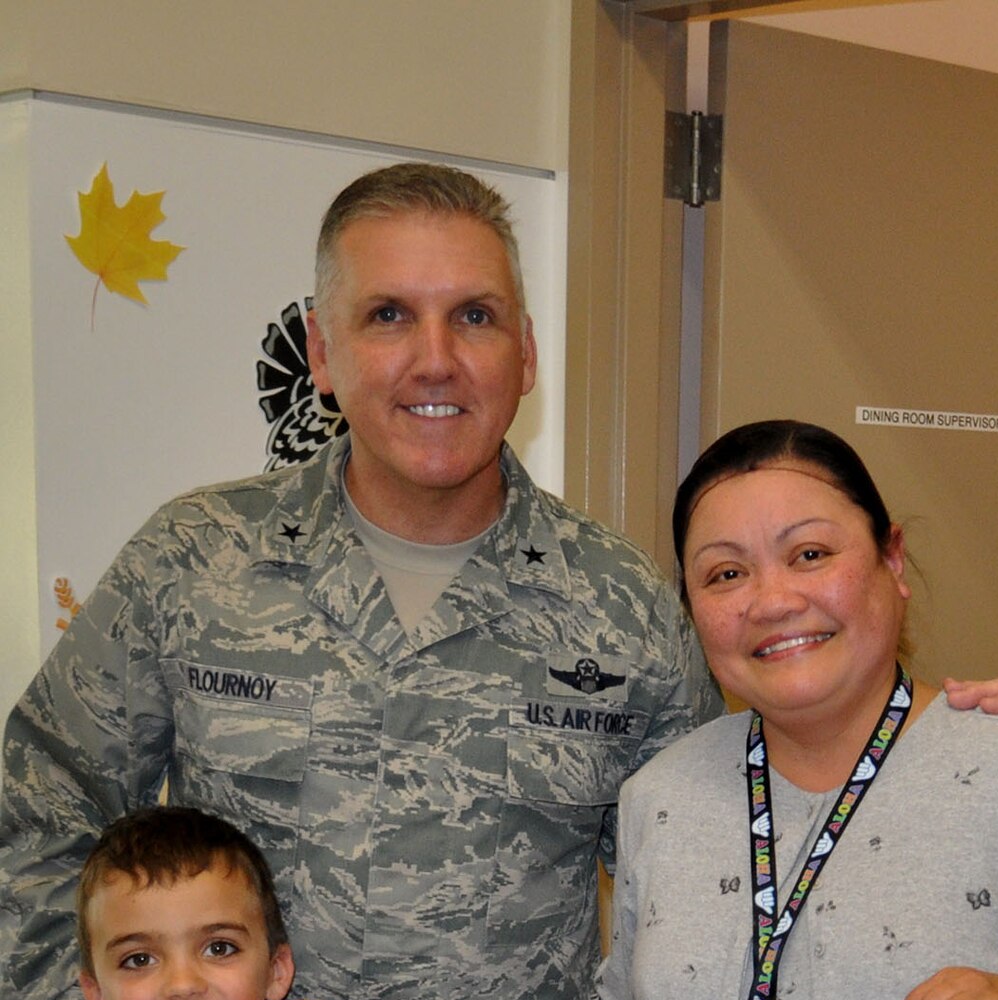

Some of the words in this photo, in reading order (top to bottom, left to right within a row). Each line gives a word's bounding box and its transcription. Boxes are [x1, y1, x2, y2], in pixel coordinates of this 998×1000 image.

[862, 409, 900, 423] DINING
[902, 412, 935, 425] ROOM
[188, 666, 278, 701] FLOURNOY
[527, 702, 558, 727] U.S.
[560, 707, 592, 731] AIR
[594, 711, 635, 735] FORCE
[868, 711, 904, 760] ALOHA
[751, 769, 767, 815] ALOHA
[828, 784, 864, 834] ALOHA
[755, 839, 772, 886] ALOHA
[789, 859, 822, 911] ALOHA
[758, 914, 773, 959] ALO
[756, 938, 782, 996] ALOHA
